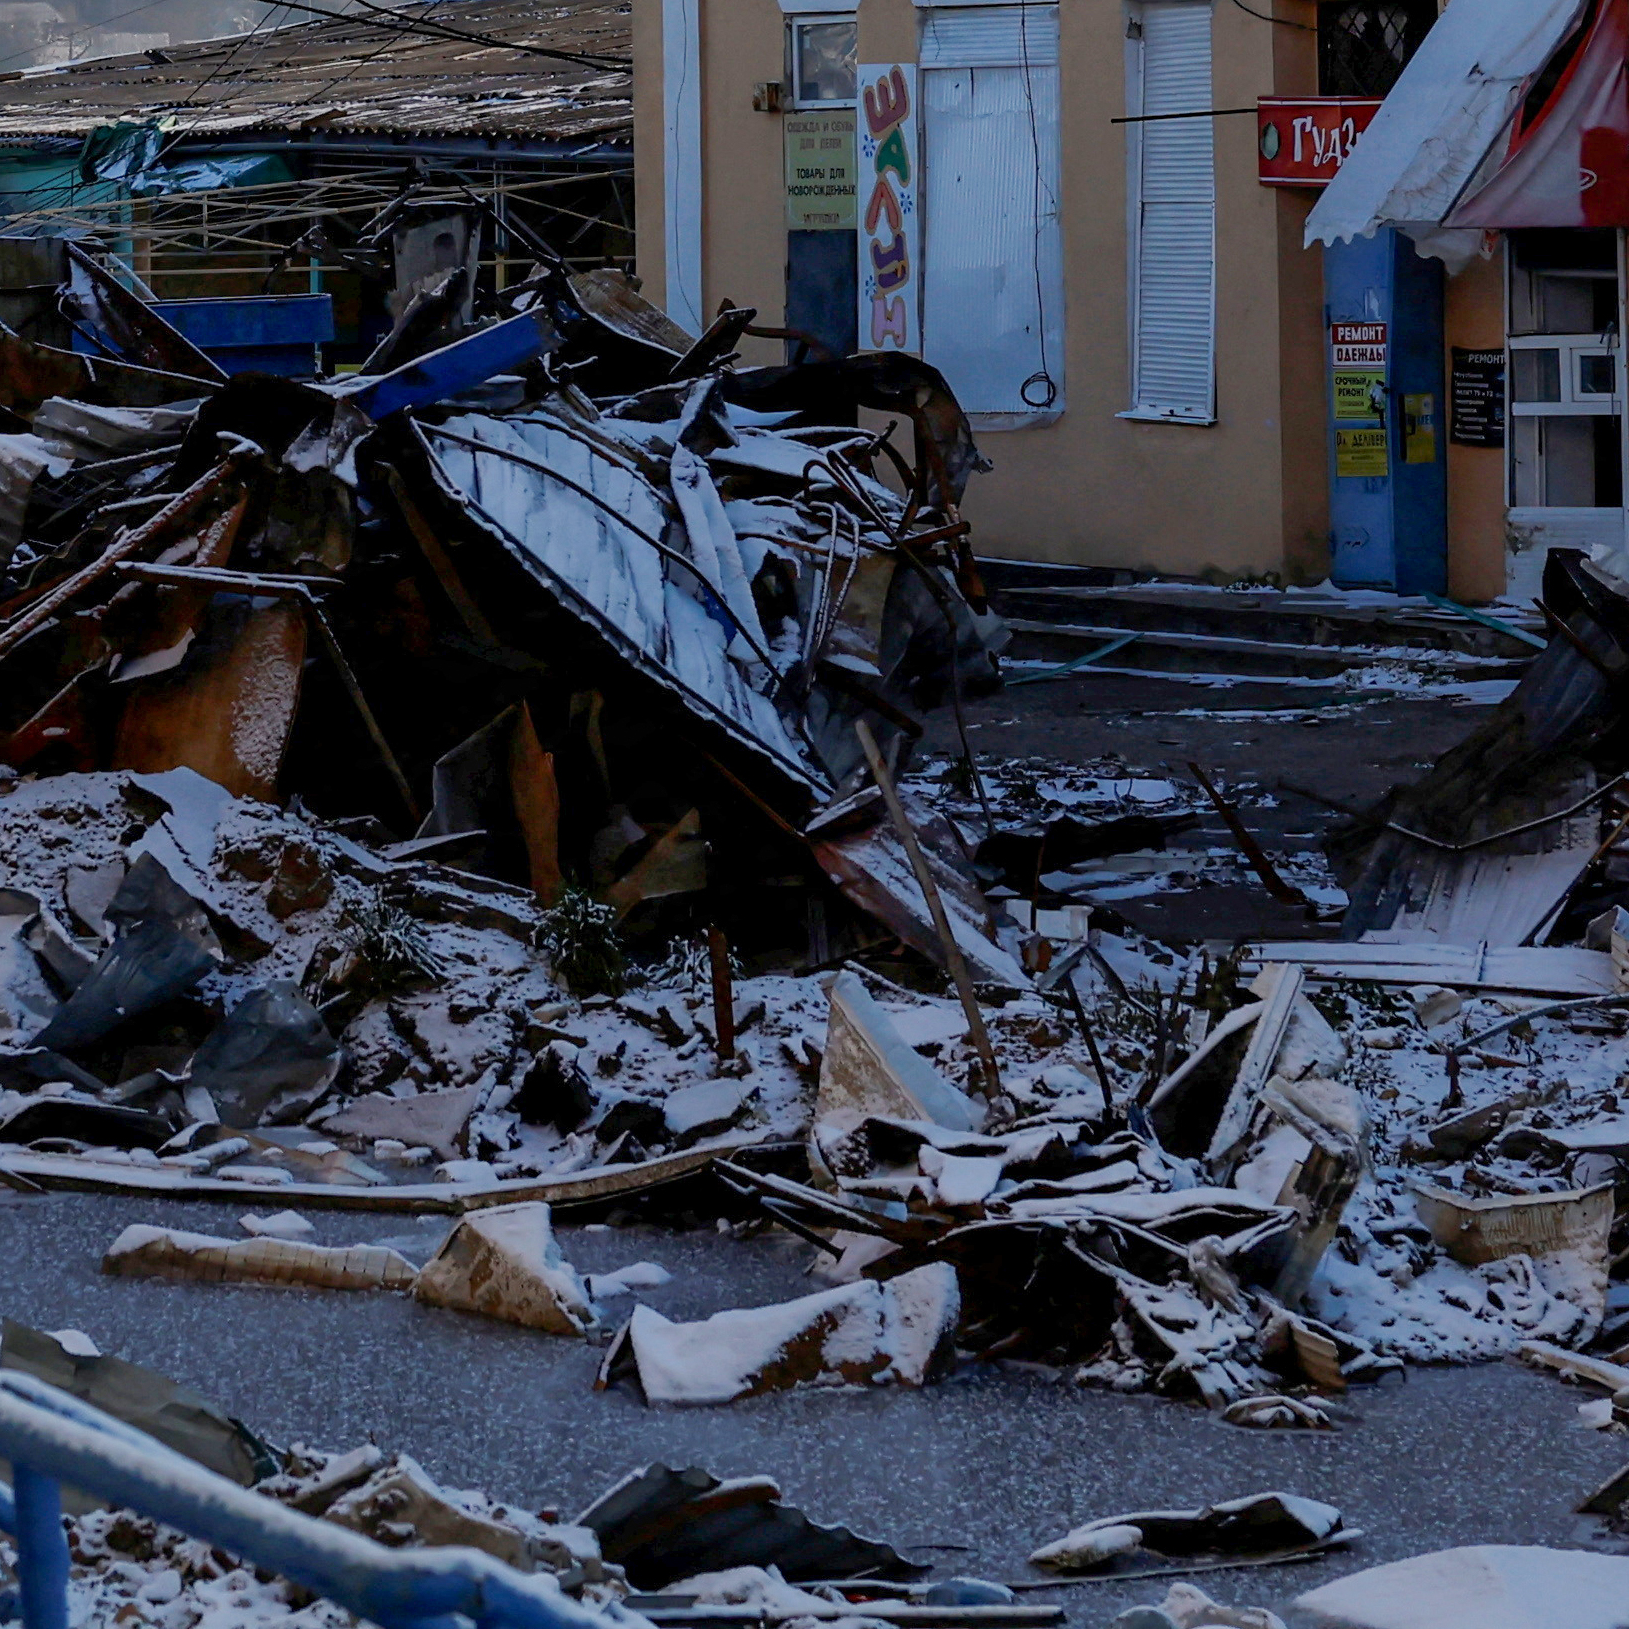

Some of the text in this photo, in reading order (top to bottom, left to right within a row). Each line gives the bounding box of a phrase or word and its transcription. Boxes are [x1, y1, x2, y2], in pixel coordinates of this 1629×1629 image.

[1292, 116, 1362, 167] Гудз
[796, 168, 845, 180] ТОВАРЫ ДЛЯ
[787, 185, 856, 198] НОВОРОЖДЕННЫХ
[1338, 326, 1384, 342] РЕМОНТ
[1337, 347, 1386, 362] ОДЕЖДЫ
[1468, 353, 1505, 365] РЕМОНТ
[1338, 388, 1365, 397] РЕМОНТ
